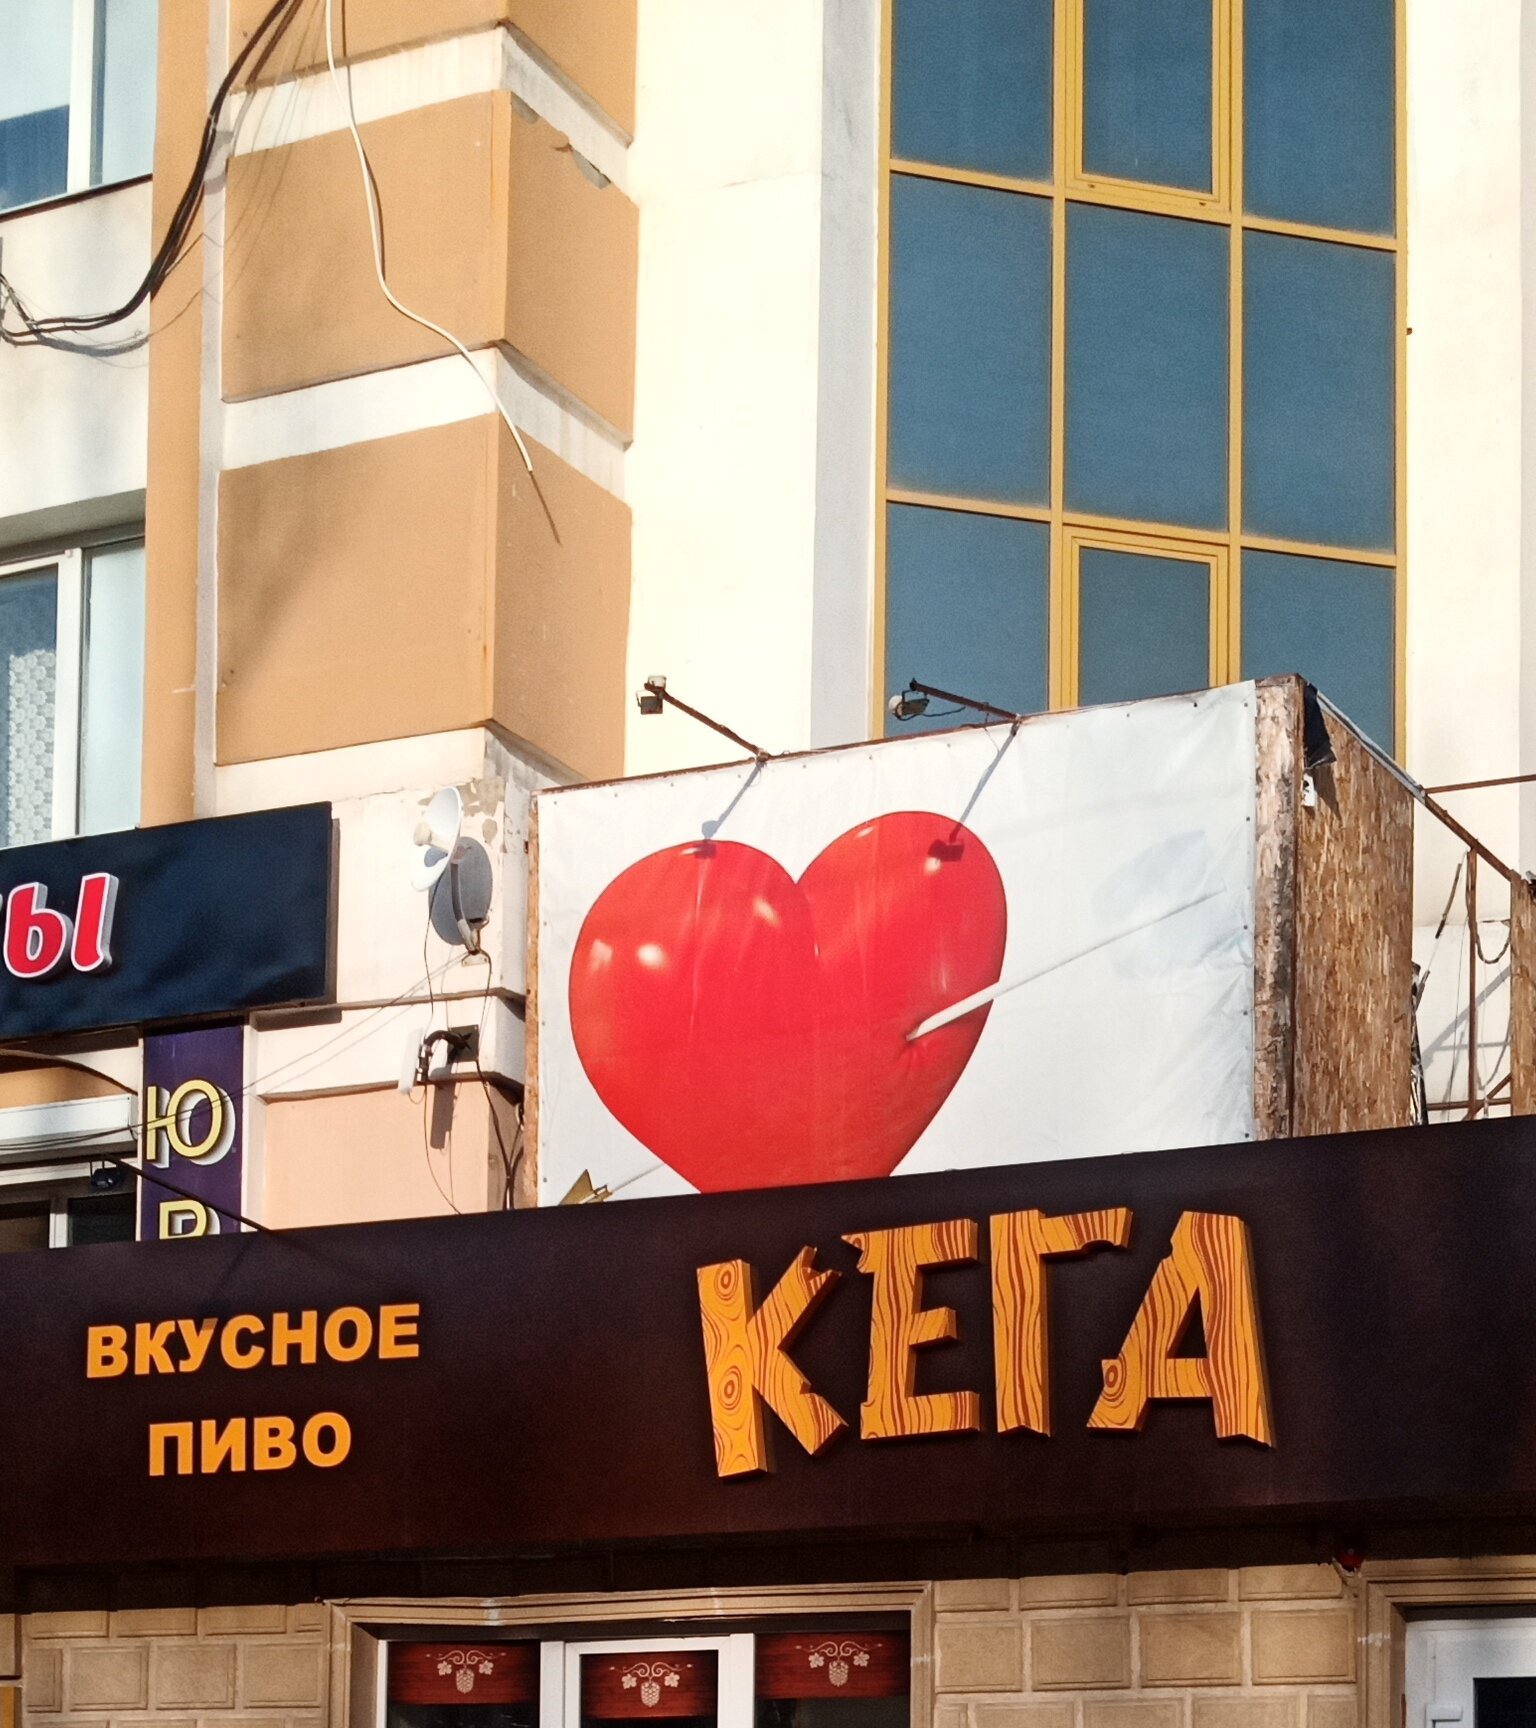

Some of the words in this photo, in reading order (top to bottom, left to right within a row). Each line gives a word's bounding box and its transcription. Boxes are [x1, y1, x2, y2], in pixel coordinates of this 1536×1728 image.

[86, 1303, 420, 1378] ВКУСНОЕ
[696, 1207, 1275, 1478] КЕГА
[149, 1412, 351, 1476] ПИВО
